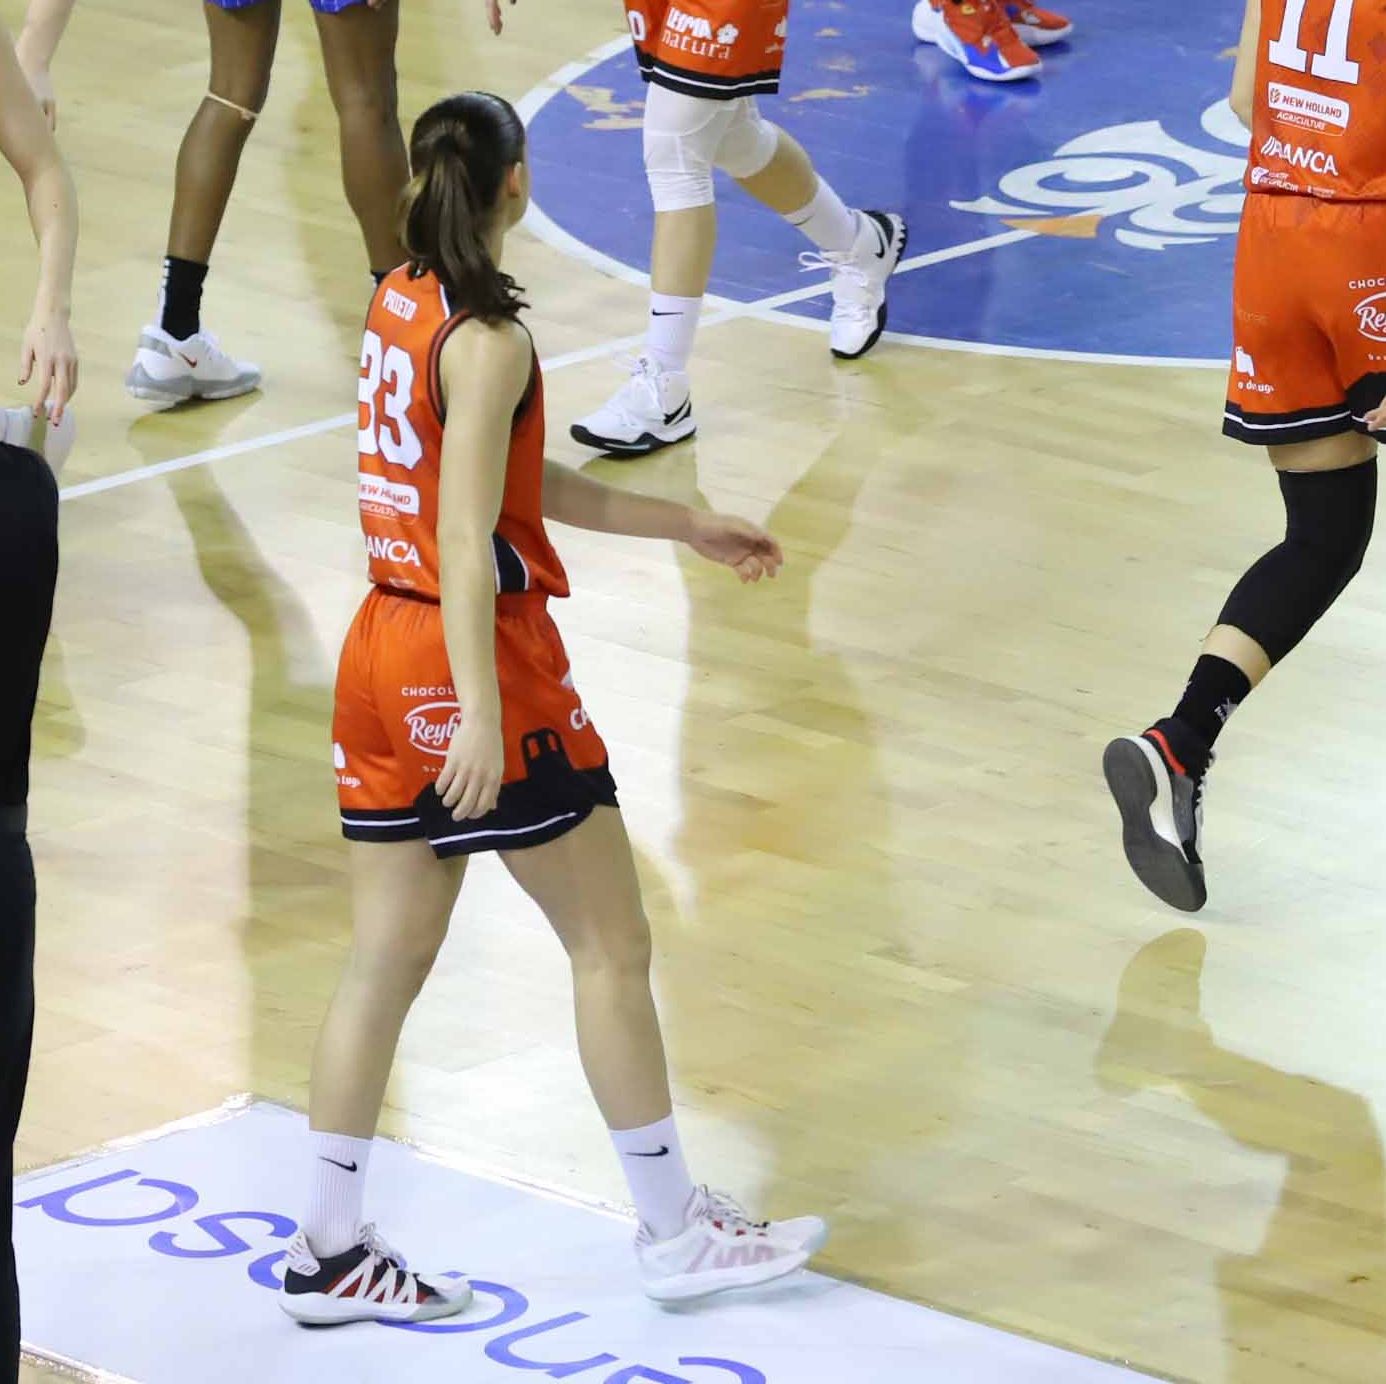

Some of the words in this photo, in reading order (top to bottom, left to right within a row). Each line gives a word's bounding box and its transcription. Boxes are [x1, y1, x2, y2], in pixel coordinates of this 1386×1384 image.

[627, 10, 646, 41] 0
[662, 29, 732, 59] natura
[1282, 96, 1304, 108] NEW
[1305, 100, 1342, 119] HOLLAND
[366, 536, 421, 567] ANCA
[401, 686, 455, 697] CHOCOL
